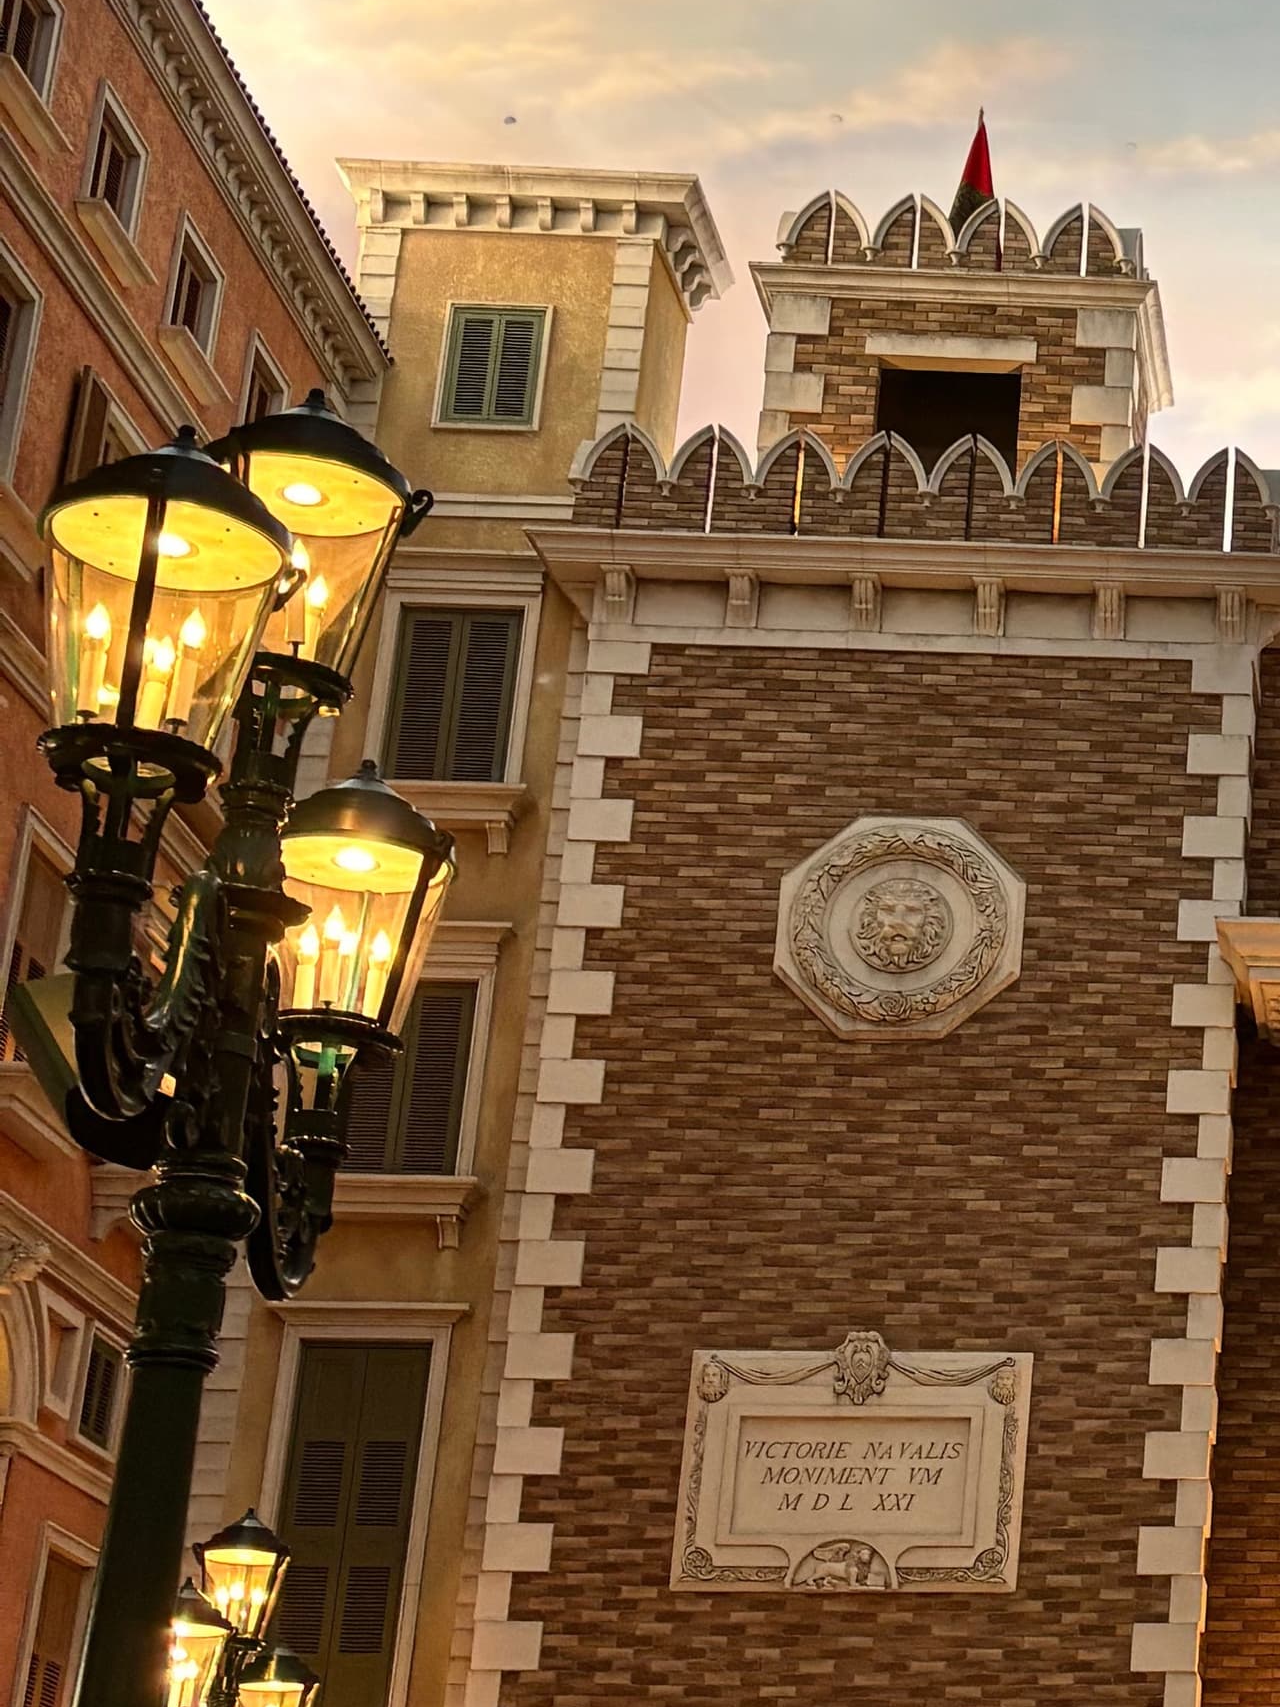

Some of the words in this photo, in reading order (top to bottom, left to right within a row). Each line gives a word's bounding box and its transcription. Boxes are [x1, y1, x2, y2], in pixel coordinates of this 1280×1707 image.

[743, 1440, 853, 1460] VICTORIE
[759, 1466, 896, 1486] MONIMENT
[907, 1467, 944, 1486] VM
